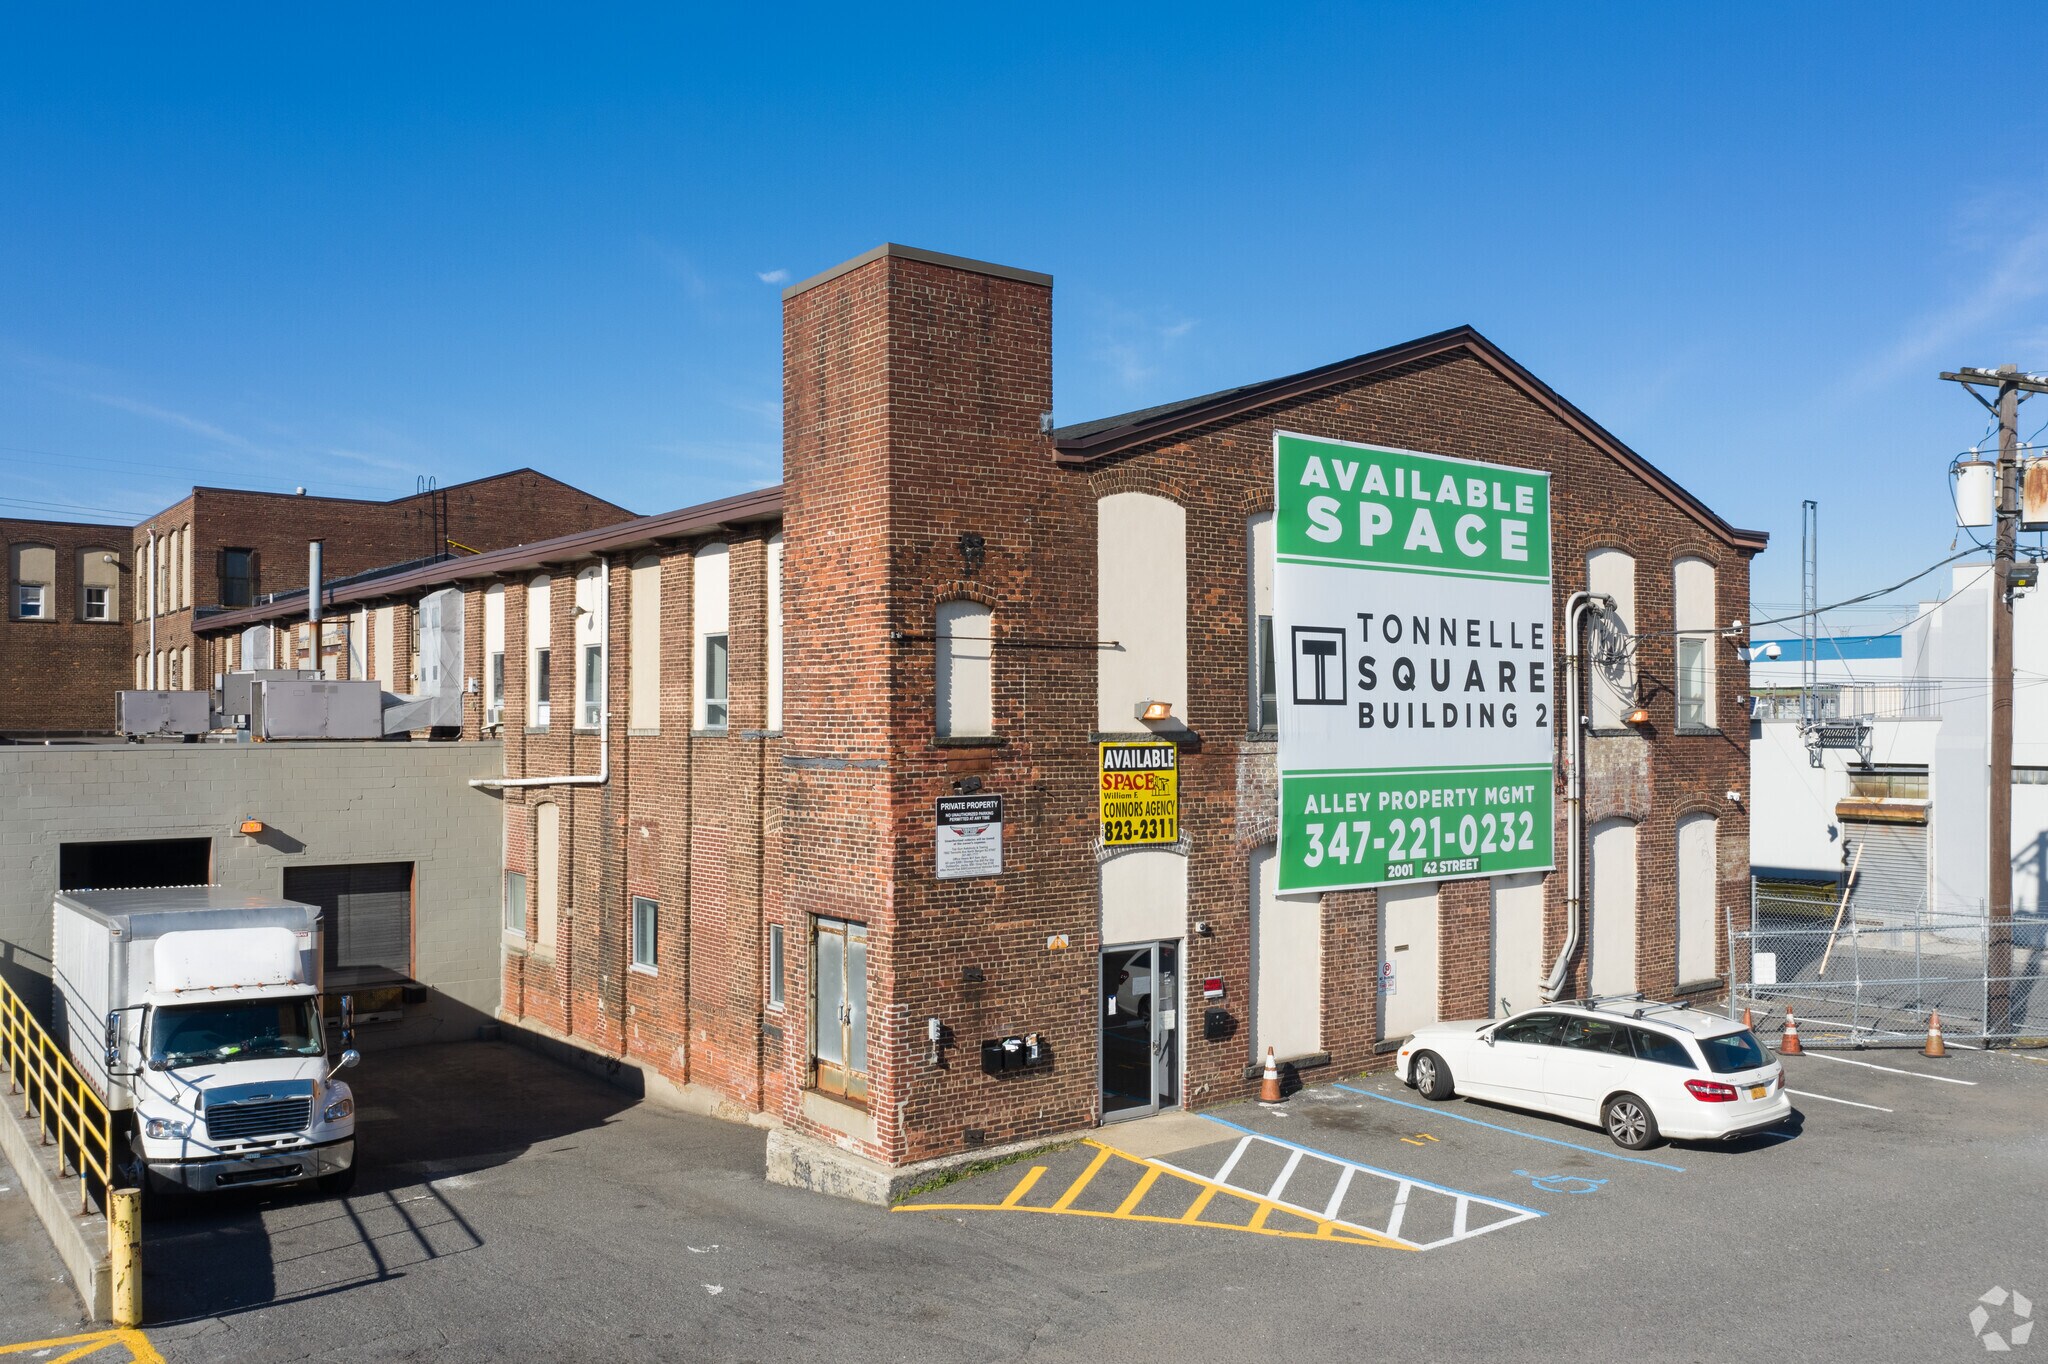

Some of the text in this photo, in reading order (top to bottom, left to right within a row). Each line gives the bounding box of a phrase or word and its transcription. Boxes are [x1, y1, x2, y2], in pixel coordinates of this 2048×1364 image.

[1300, 456, 1533, 514] AVAILABLE
[1305, 496, 1528, 561] SPACE
[1357, 613, 1544, 649] TONNELLE
[1358, 656, 1545, 692] SQUARE
[1359, 702, 1547, 728] BUILDING 2
[1104, 749, 1174, 769] AVAILABLE
[1102, 773, 1156, 791] SPACE
[966, 801, 998, 809] PROPERTY
[1104, 800, 1175, 818] CONNORS AGENCY
[1304, 785, 1535, 814] ALLEY PROPERTY MGMT
[1105, 818, 1174, 841] 823-2311
[1303, 810, 1534, 867] 347-221-0232
[1388, 858, 1479, 878] 2001 42 STREET
